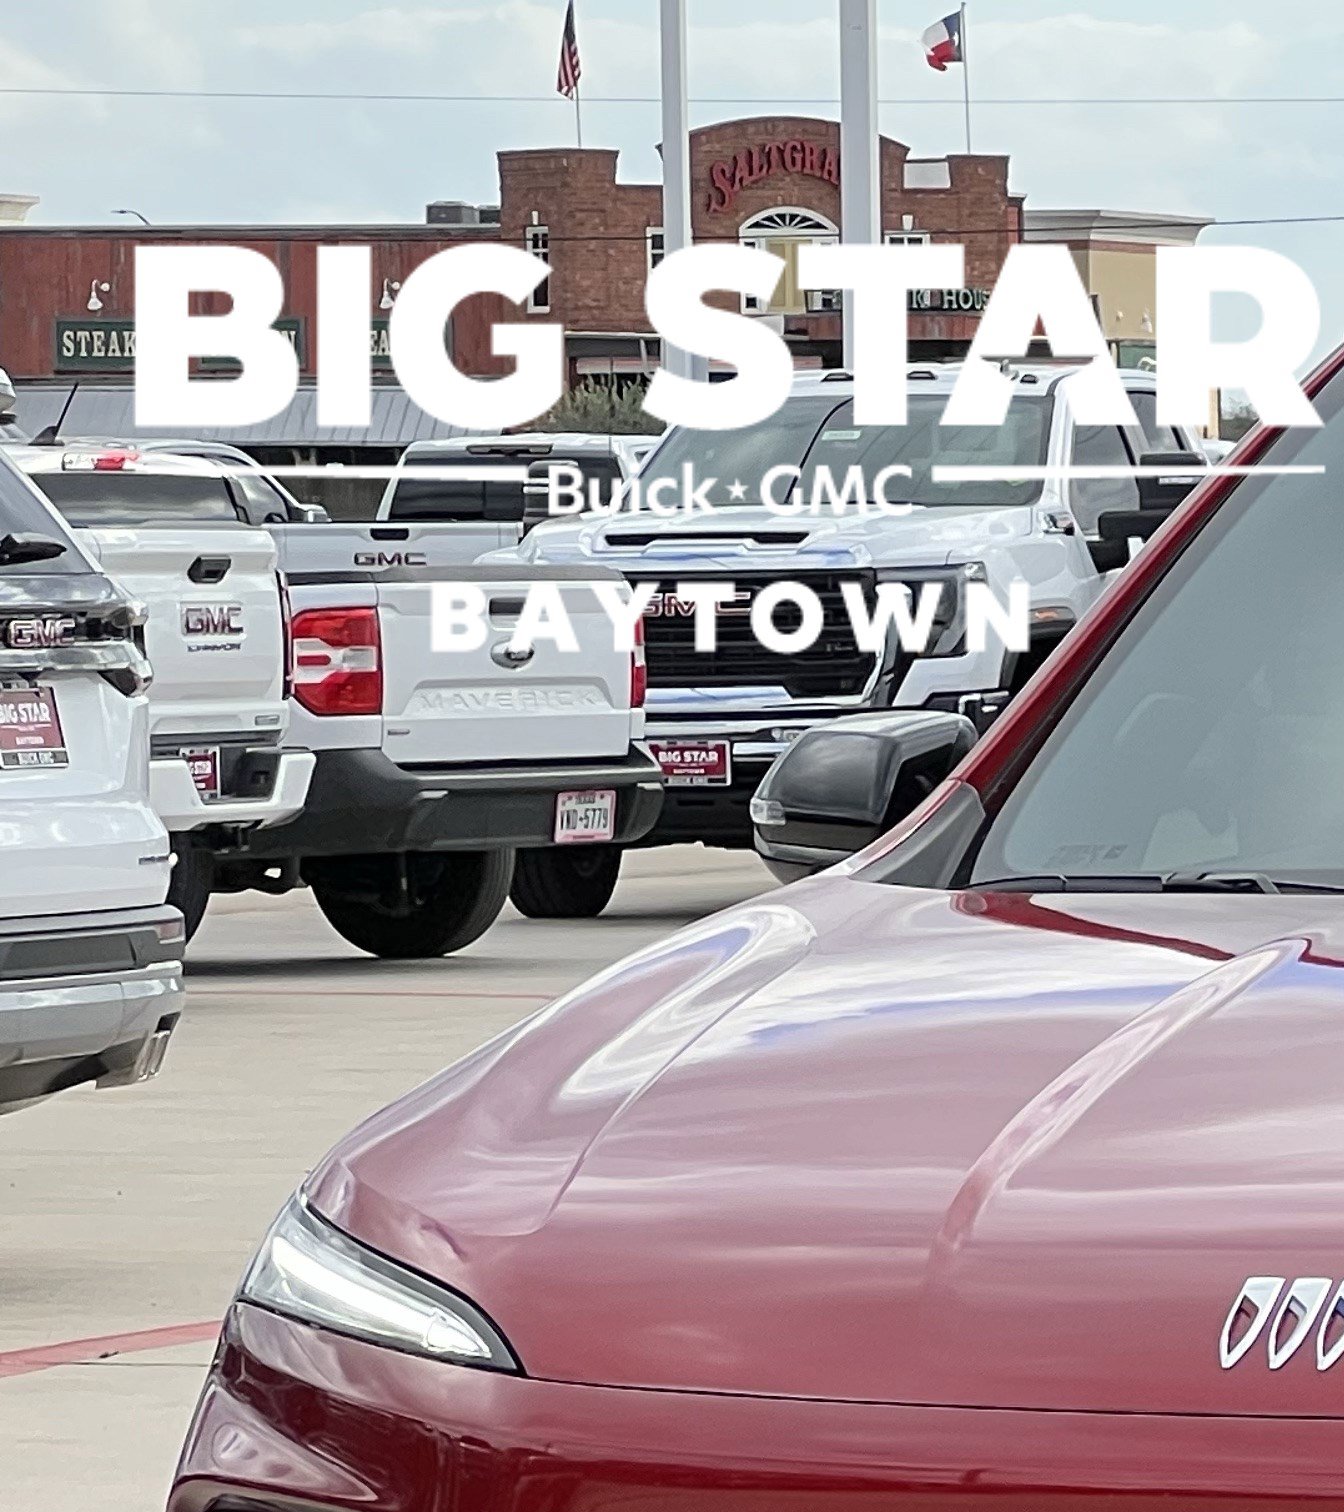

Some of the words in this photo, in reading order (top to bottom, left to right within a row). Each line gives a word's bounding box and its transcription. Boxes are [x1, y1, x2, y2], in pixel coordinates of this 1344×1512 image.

[707, 140, 841, 213] SALTGRA
[943, 289, 992, 310] HOUS
[354, 552, 427, 566] GMC
[185, 607, 244, 635] GMC
[10, 618, 76, 648] GMC
[418, 689, 597, 710] MAVERICK
[18, 703, 51, 724] STAR
[658, 750, 681, 762] BIG
[683, 750, 719, 762] STAR
